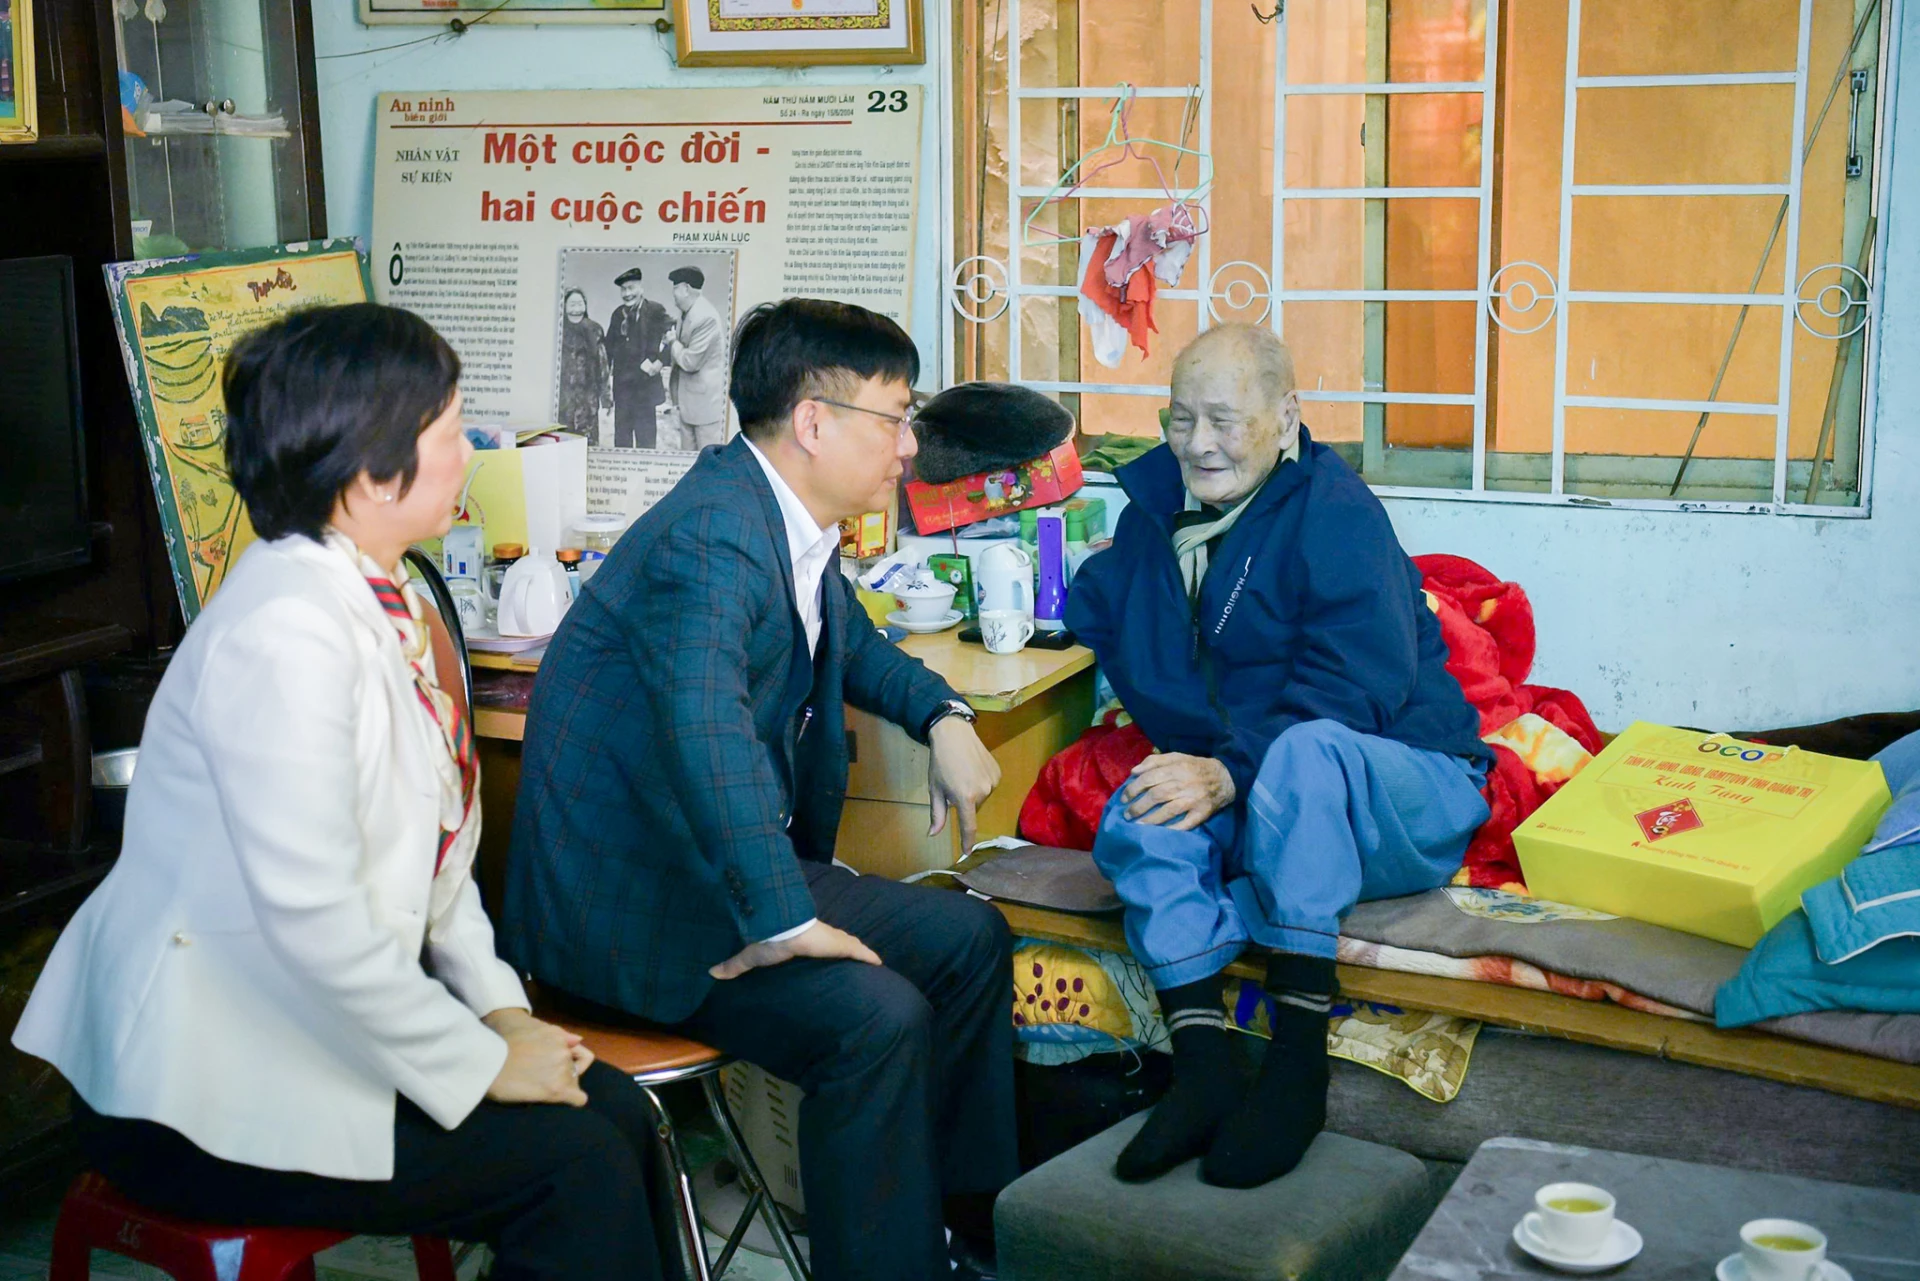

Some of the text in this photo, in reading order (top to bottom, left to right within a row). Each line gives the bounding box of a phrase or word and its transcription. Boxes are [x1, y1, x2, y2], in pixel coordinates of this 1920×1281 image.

[390, 97, 455, 112] An ninh
[867, 90, 908, 113] 23
[404, 112, 425, 122] biên
[395, 147, 460, 163] NHÂN VẬT
[483, 132, 557, 172] Một
[572, 132, 665, 172] cuộc
[681, 131, 740, 164] đời
[401, 168, 453, 185] SỰ KIỆN
[481, 187, 766, 230] hai cuộc chiến
[702, 230, 728, 242] XUÂN
[731, 232, 751, 243] LỤC
[1224, 577, 1245, 614] HAGITO
[1698, 742, 1784, 764] OCOP
[1767, 781, 1799, 796] QUẢNG
